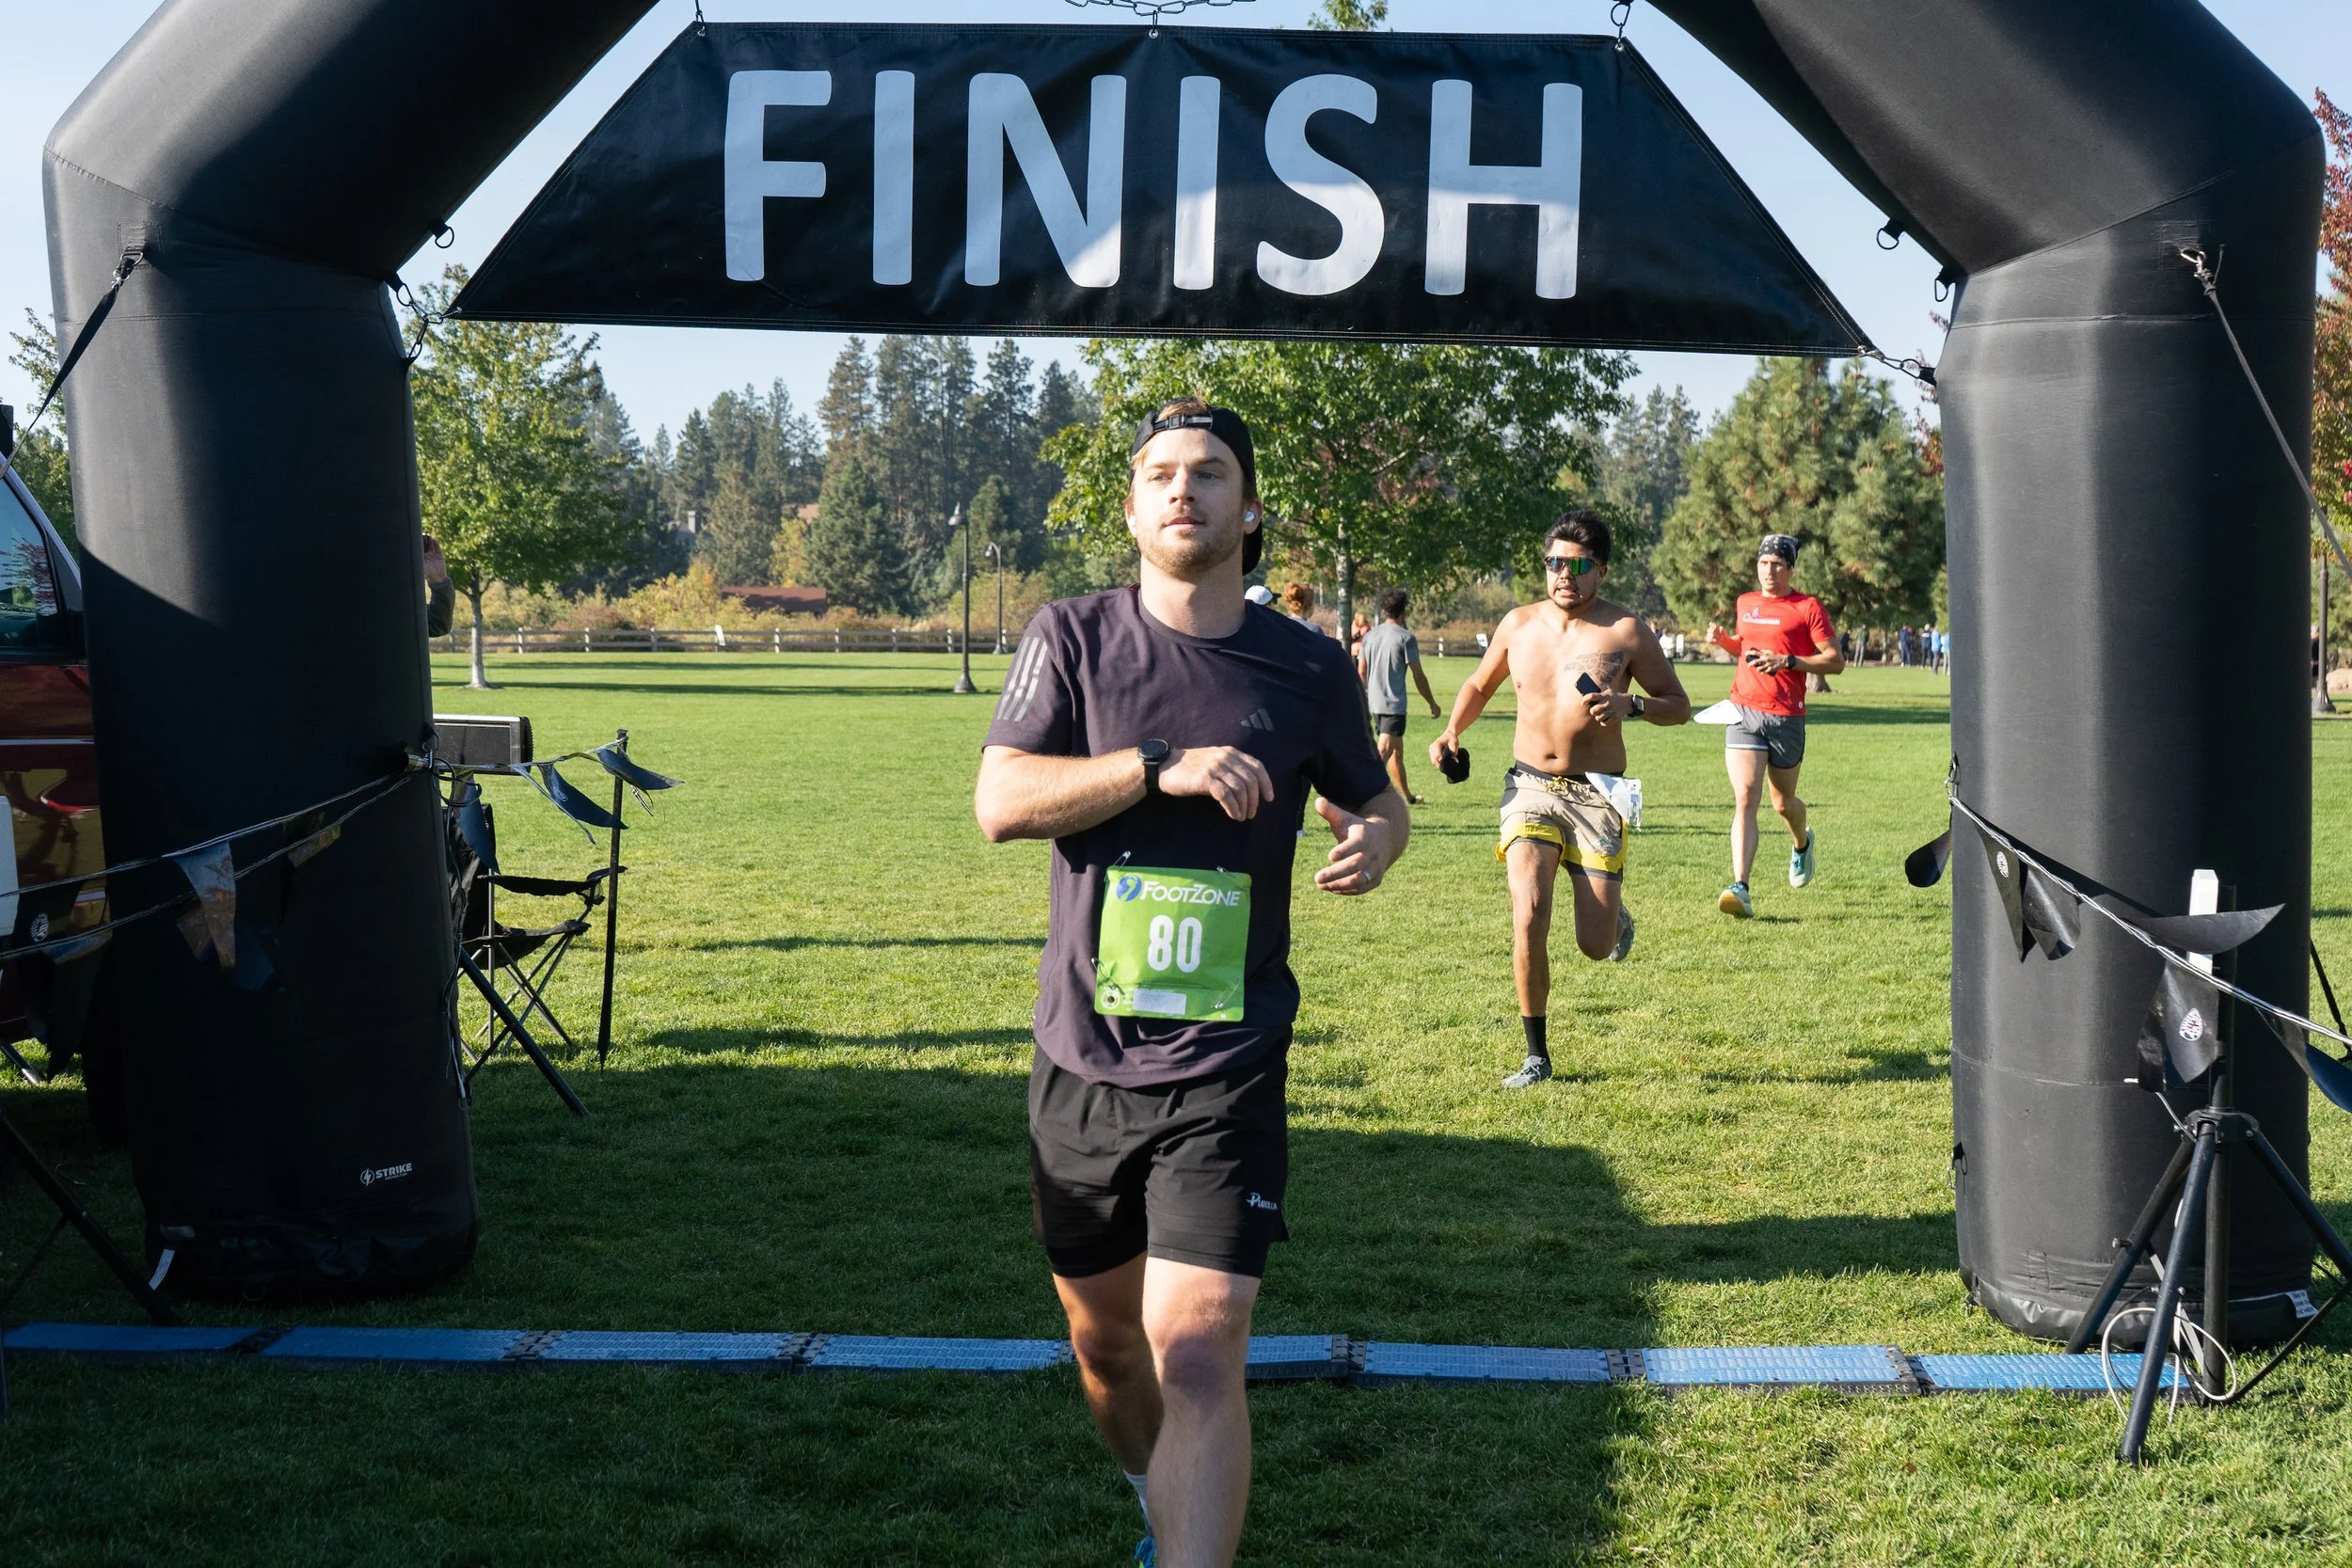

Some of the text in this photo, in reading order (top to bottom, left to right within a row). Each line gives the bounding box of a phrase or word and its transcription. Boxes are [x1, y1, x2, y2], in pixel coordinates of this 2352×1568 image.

[723, 70, 1583, 300] FINISH
[1148, 914, 1202, 974] 80
[375, 1163, 413, 1179] STRIKE
